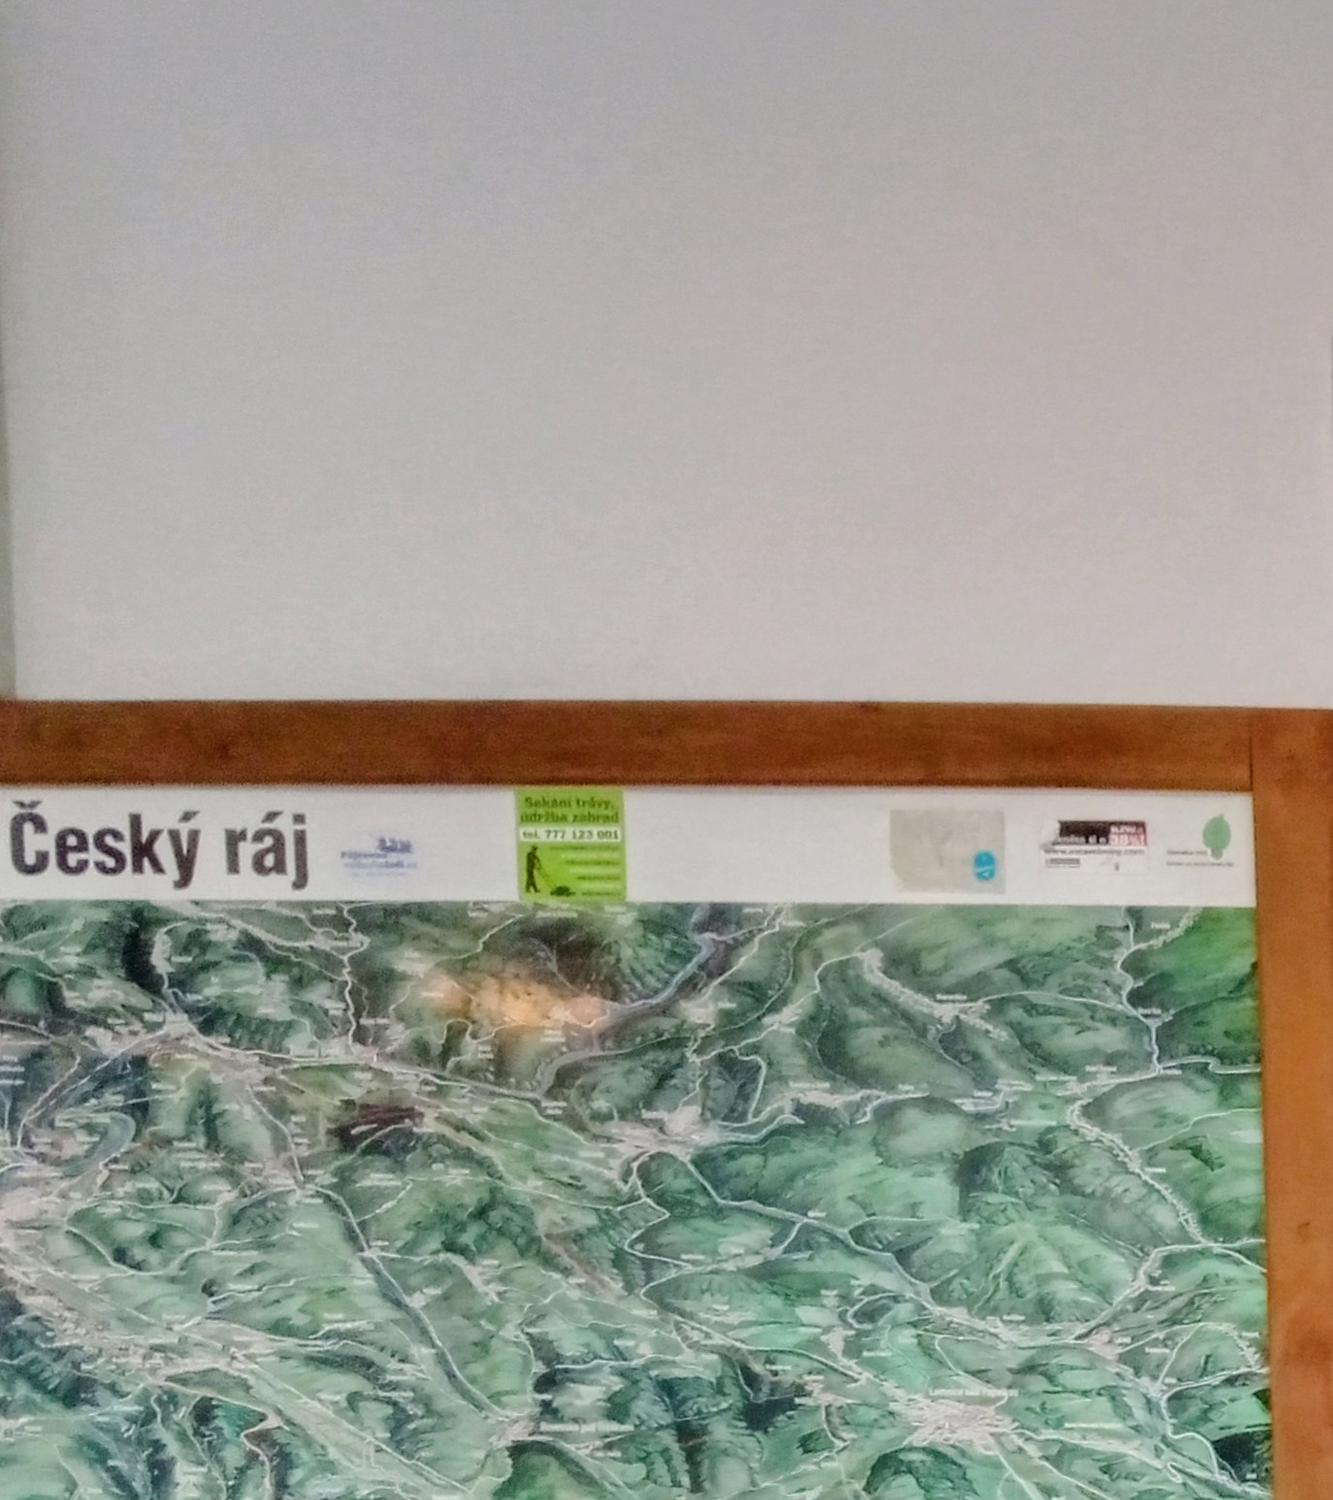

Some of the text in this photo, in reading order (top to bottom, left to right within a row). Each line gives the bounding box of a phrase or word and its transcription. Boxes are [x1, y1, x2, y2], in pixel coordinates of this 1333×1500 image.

[10, 800, 309, 890] Český ráj
[545, 829, 566, 840] 777
[571, 829, 593, 840] 123
[597, 829, 619, 840] 001
